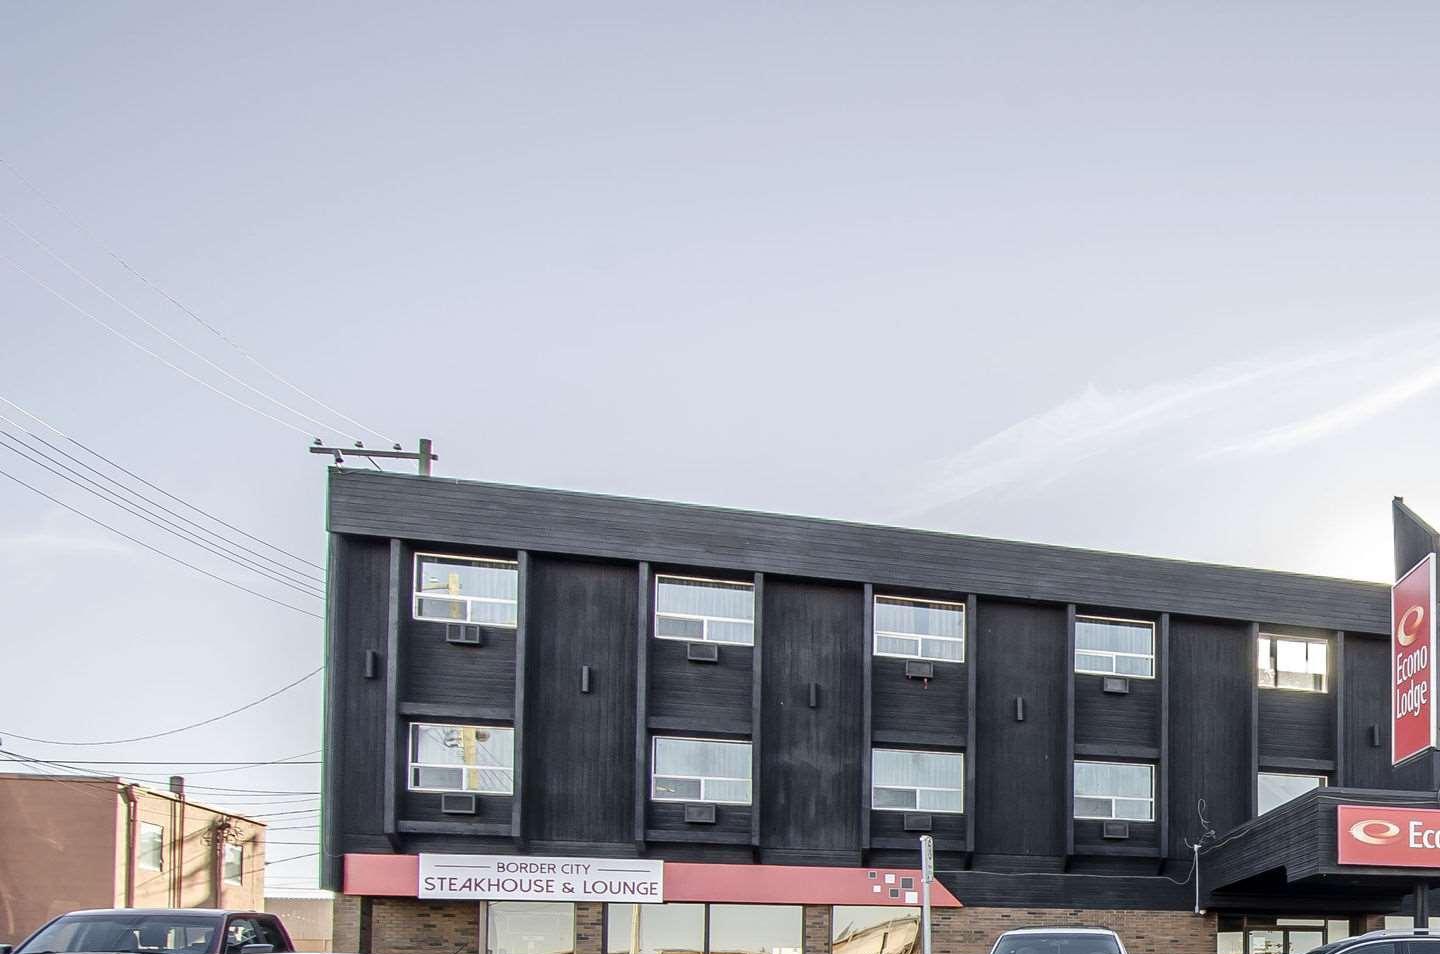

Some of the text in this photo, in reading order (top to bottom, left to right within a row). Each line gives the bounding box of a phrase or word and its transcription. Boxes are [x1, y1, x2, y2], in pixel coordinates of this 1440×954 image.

[1396, 645, 1428, 686] Econo
[1396, 680, 1428, 719] Lodge
[496, 862, 591, 875] BORDER CITY
[424, 877, 658, 896] STEAKHOUSE & LOUNGE
